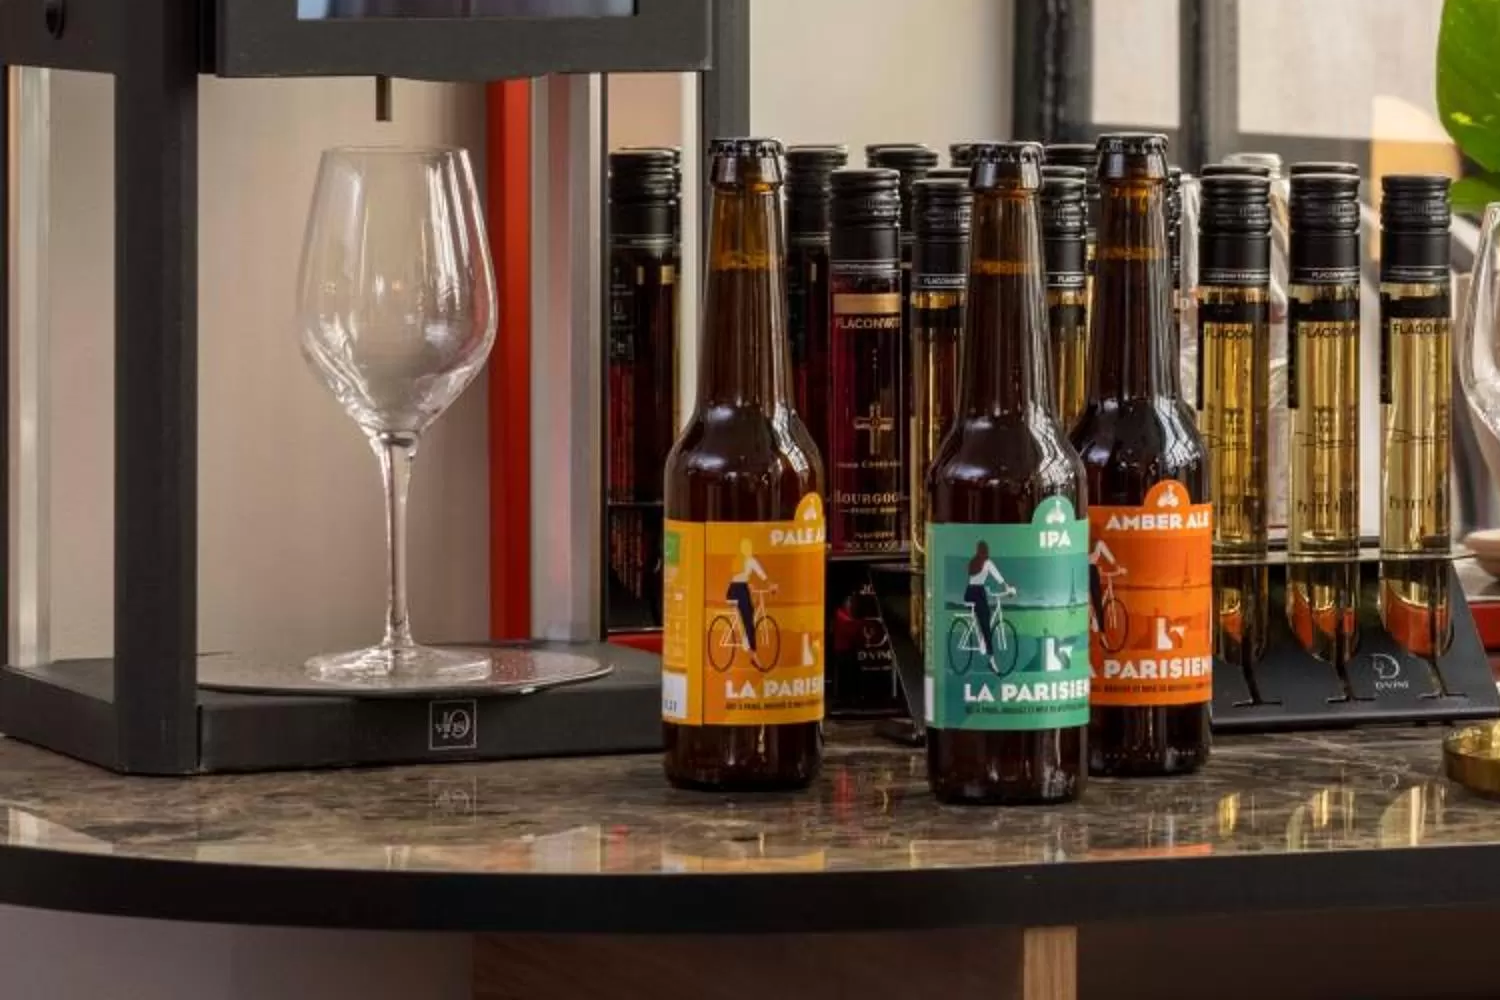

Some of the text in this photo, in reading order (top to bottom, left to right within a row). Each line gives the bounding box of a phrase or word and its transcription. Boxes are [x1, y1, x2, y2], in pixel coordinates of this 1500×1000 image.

[1105, 512, 1183, 531] AMBER
[769, 527, 815, 547] PALE
[1039, 529, 1072, 549] IPA
[724, 679, 757, 700] LA
[963, 683, 995, 703] LA
